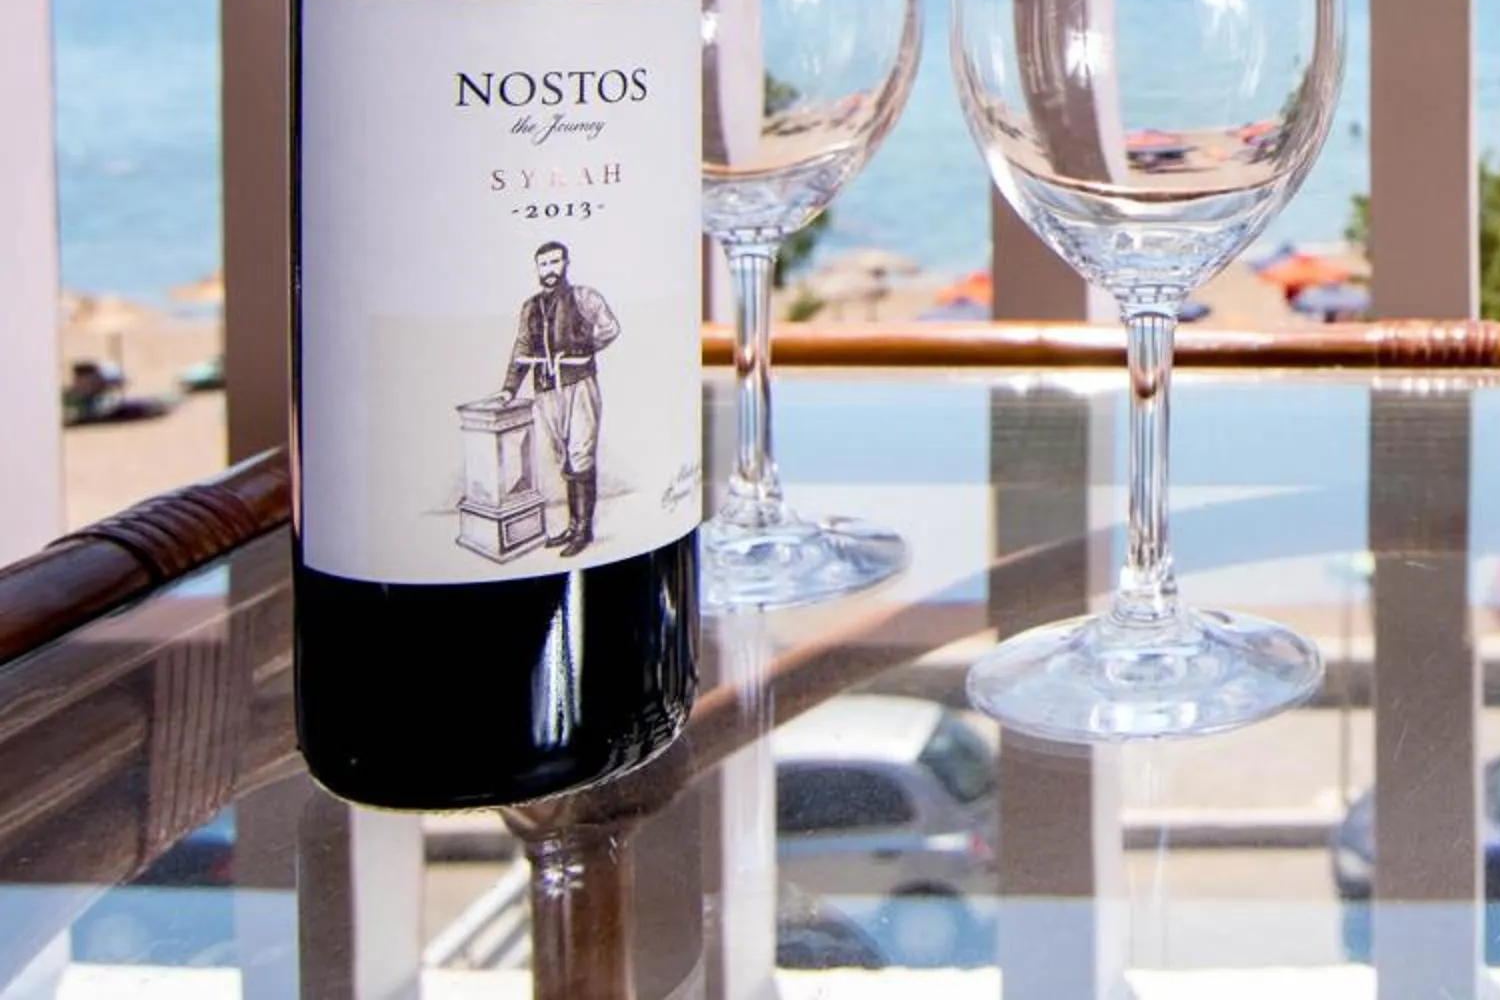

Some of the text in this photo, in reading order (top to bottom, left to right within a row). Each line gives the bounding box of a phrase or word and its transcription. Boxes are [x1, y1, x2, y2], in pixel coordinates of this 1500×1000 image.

[455, 68, 648, 106] NOSTOS
[510, 113, 606, 146] the Journey
